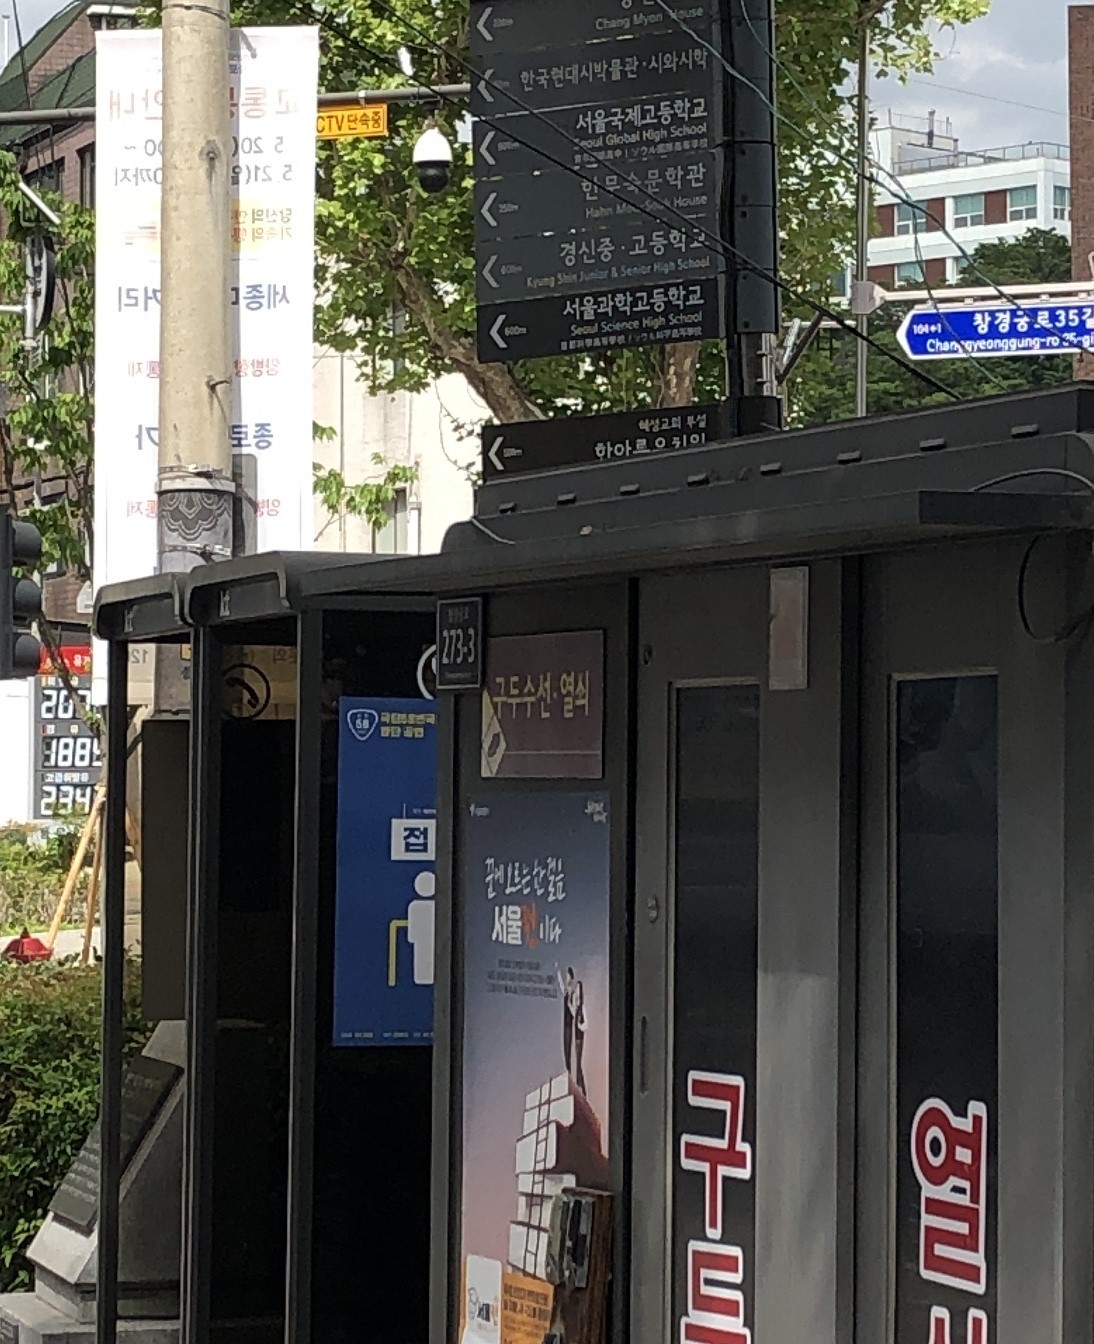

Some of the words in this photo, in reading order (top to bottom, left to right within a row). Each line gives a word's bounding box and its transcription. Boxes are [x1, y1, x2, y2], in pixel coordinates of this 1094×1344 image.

[595, 16, 630, 32] Chang
[633, 12, 663, 27] Myon
[347, 111, 381, 131] 단속중
[576, 98, 708, 134] 서울국제고등학교
[605, 131, 640, 146] Global
[643, 128, 667, 143] High
[670, 122, 707, 139] School
[673, 194, 709, 208] House
[526, 274, 555, 288] Kyung
[621, 263, 651, 277] Senior
[653, 259, 676, 272] High
[678, 256, 710, 270] School
[563, 285, 705, 320] 서울과학고등학교
[570, 323, 599, 337] Seoul
[601, 318, 639, 332] Science
[642, 314, 666, 329] High
[668, 310, 703, 326] School
[442, 627, 475, 664] 273-3
[492, 670, 589, 719] 구두수선·열쇠
